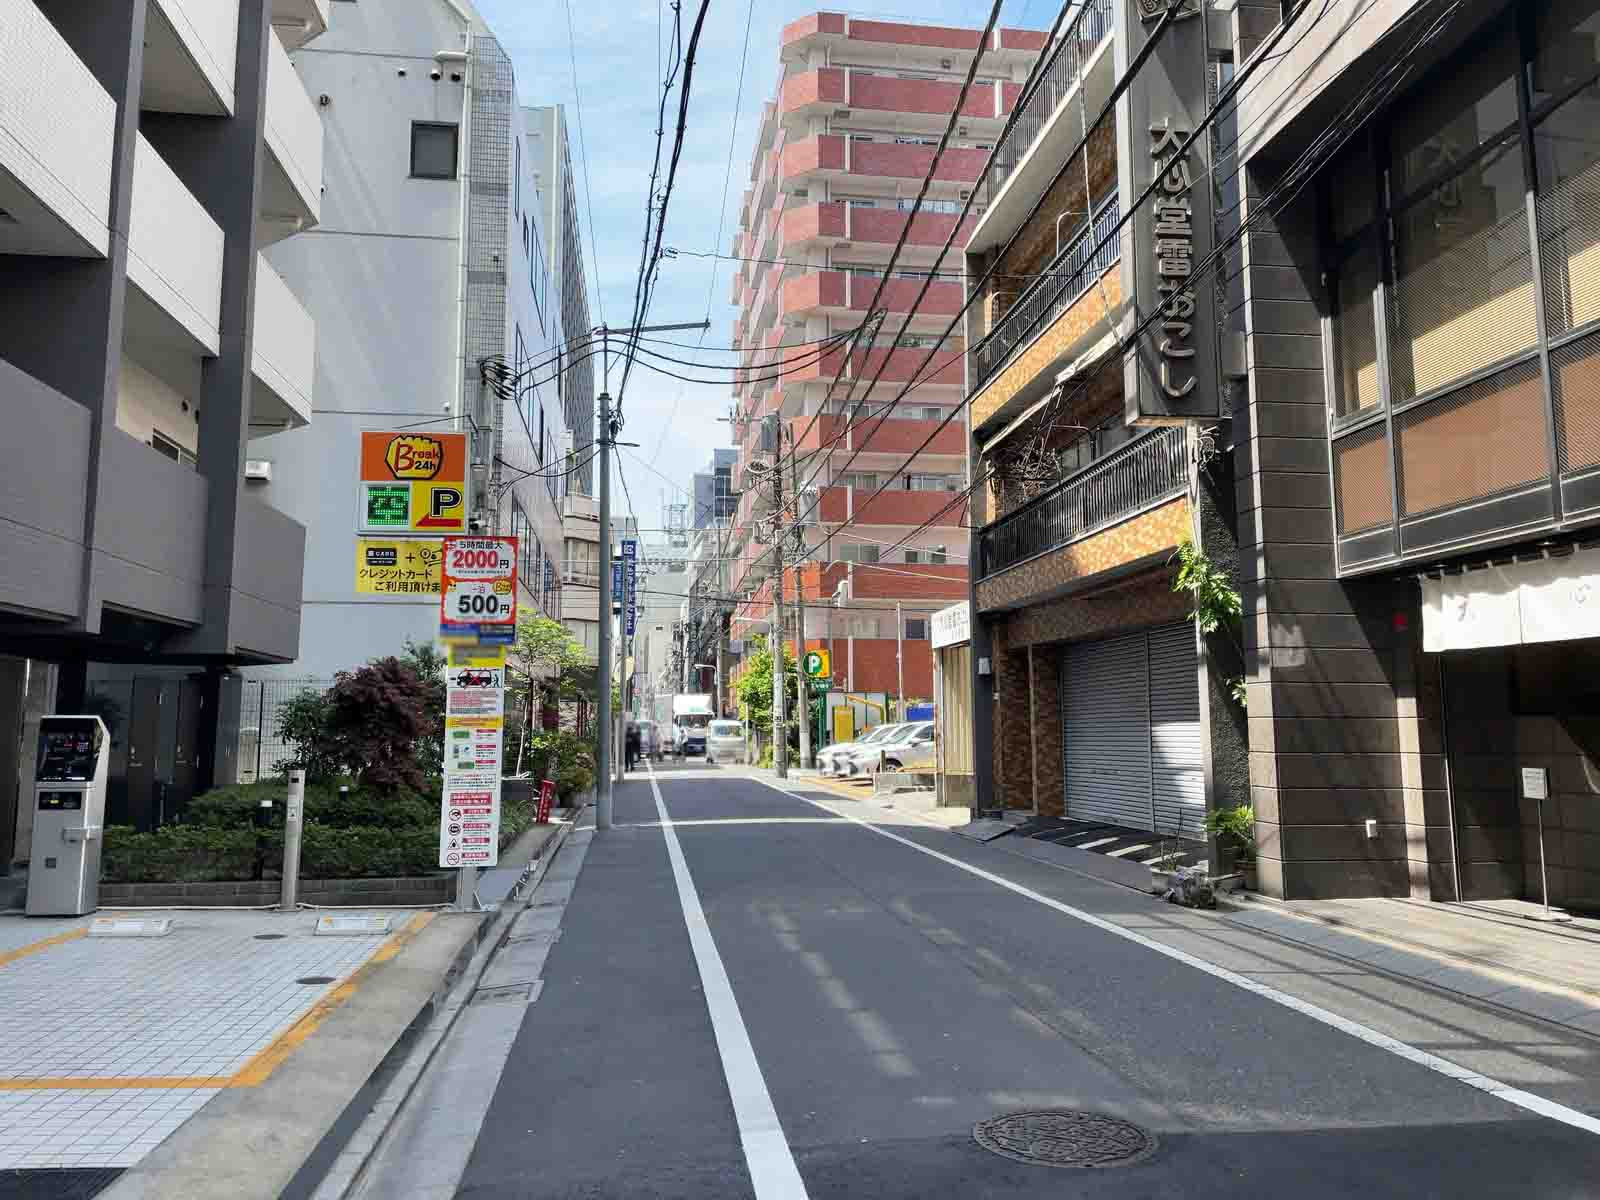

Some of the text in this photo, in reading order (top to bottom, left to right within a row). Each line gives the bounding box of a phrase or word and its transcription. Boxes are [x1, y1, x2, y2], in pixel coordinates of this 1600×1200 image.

[394, 441, 440, 472] Break
[414, 461, 437, 470] 24h
[430, 487, 463, 518] P
[452, 551, 509, 569] 2000円
[359, 568, 433, 580] クレジットカード
[457, 594, 510, 614] 500円
[808, 655, 820, 673] P
